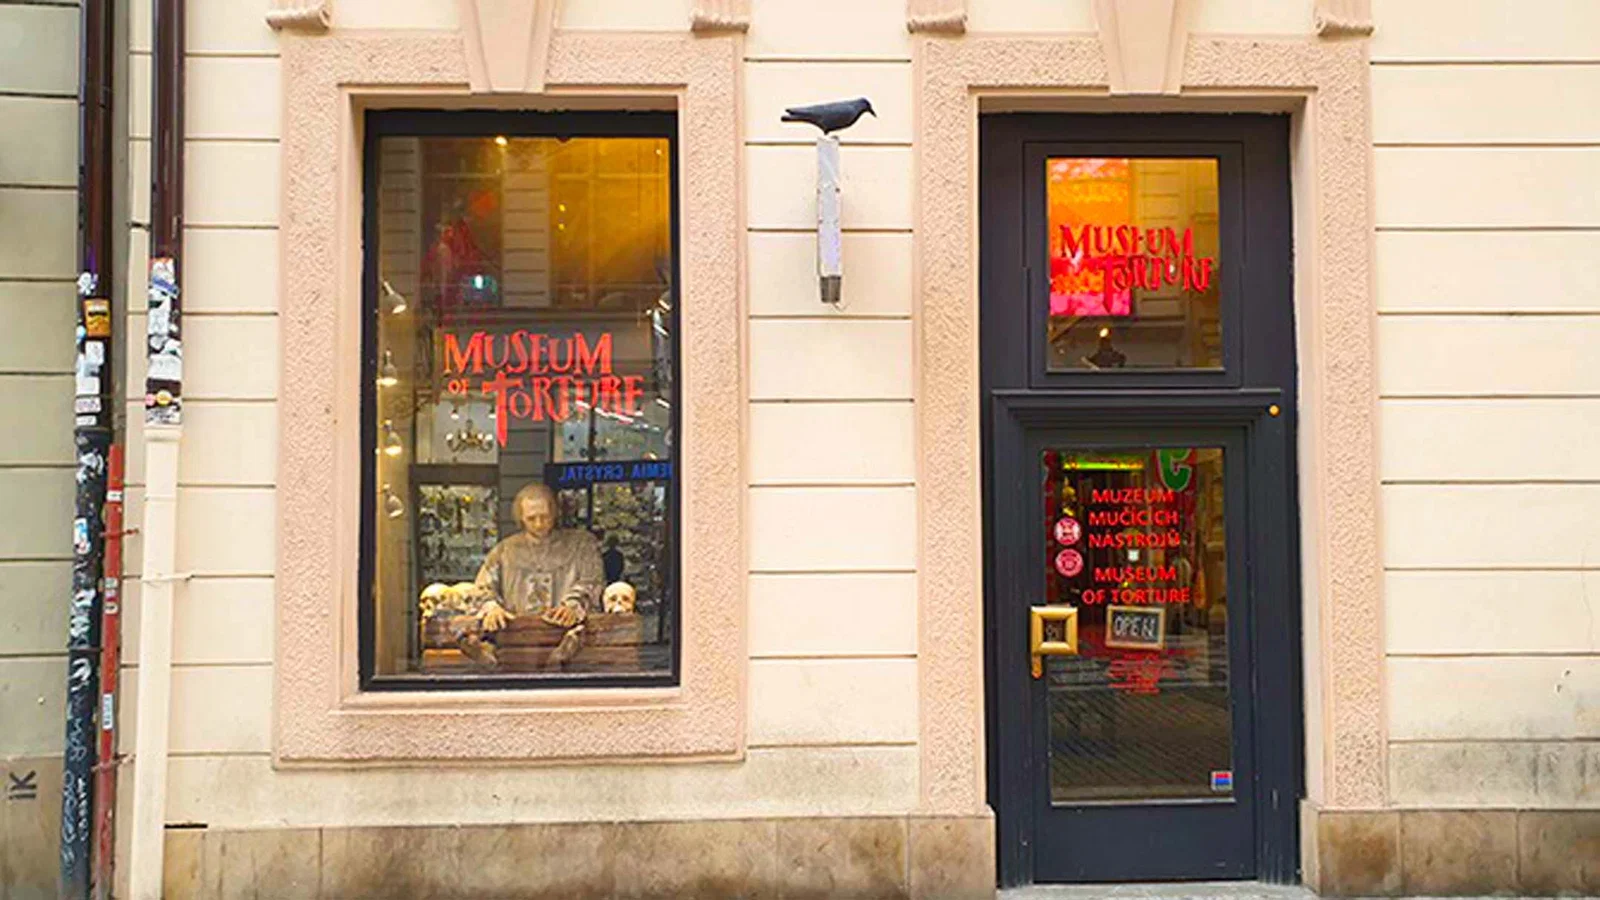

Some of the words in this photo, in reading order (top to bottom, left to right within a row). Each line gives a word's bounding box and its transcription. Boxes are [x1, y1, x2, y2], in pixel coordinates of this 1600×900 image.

[1060, 224, 1194, 258] MUSEUM
[1100, 256, 1213, 313] TORTURE
[443, 329, 612, 375] MUSEUM
[448, 378, 469, 396] OF
[483, 373, 645, 448] TORTURE
[1092, 488, 1174, 503] MUZEUM
[1094, 566, 1176, 582] MUSEUM
[1082, 589, 1105, 605] OF
[1111, 587, 1190, 604] TORTURE
[1114, 616, 1155, 640] OPEN
